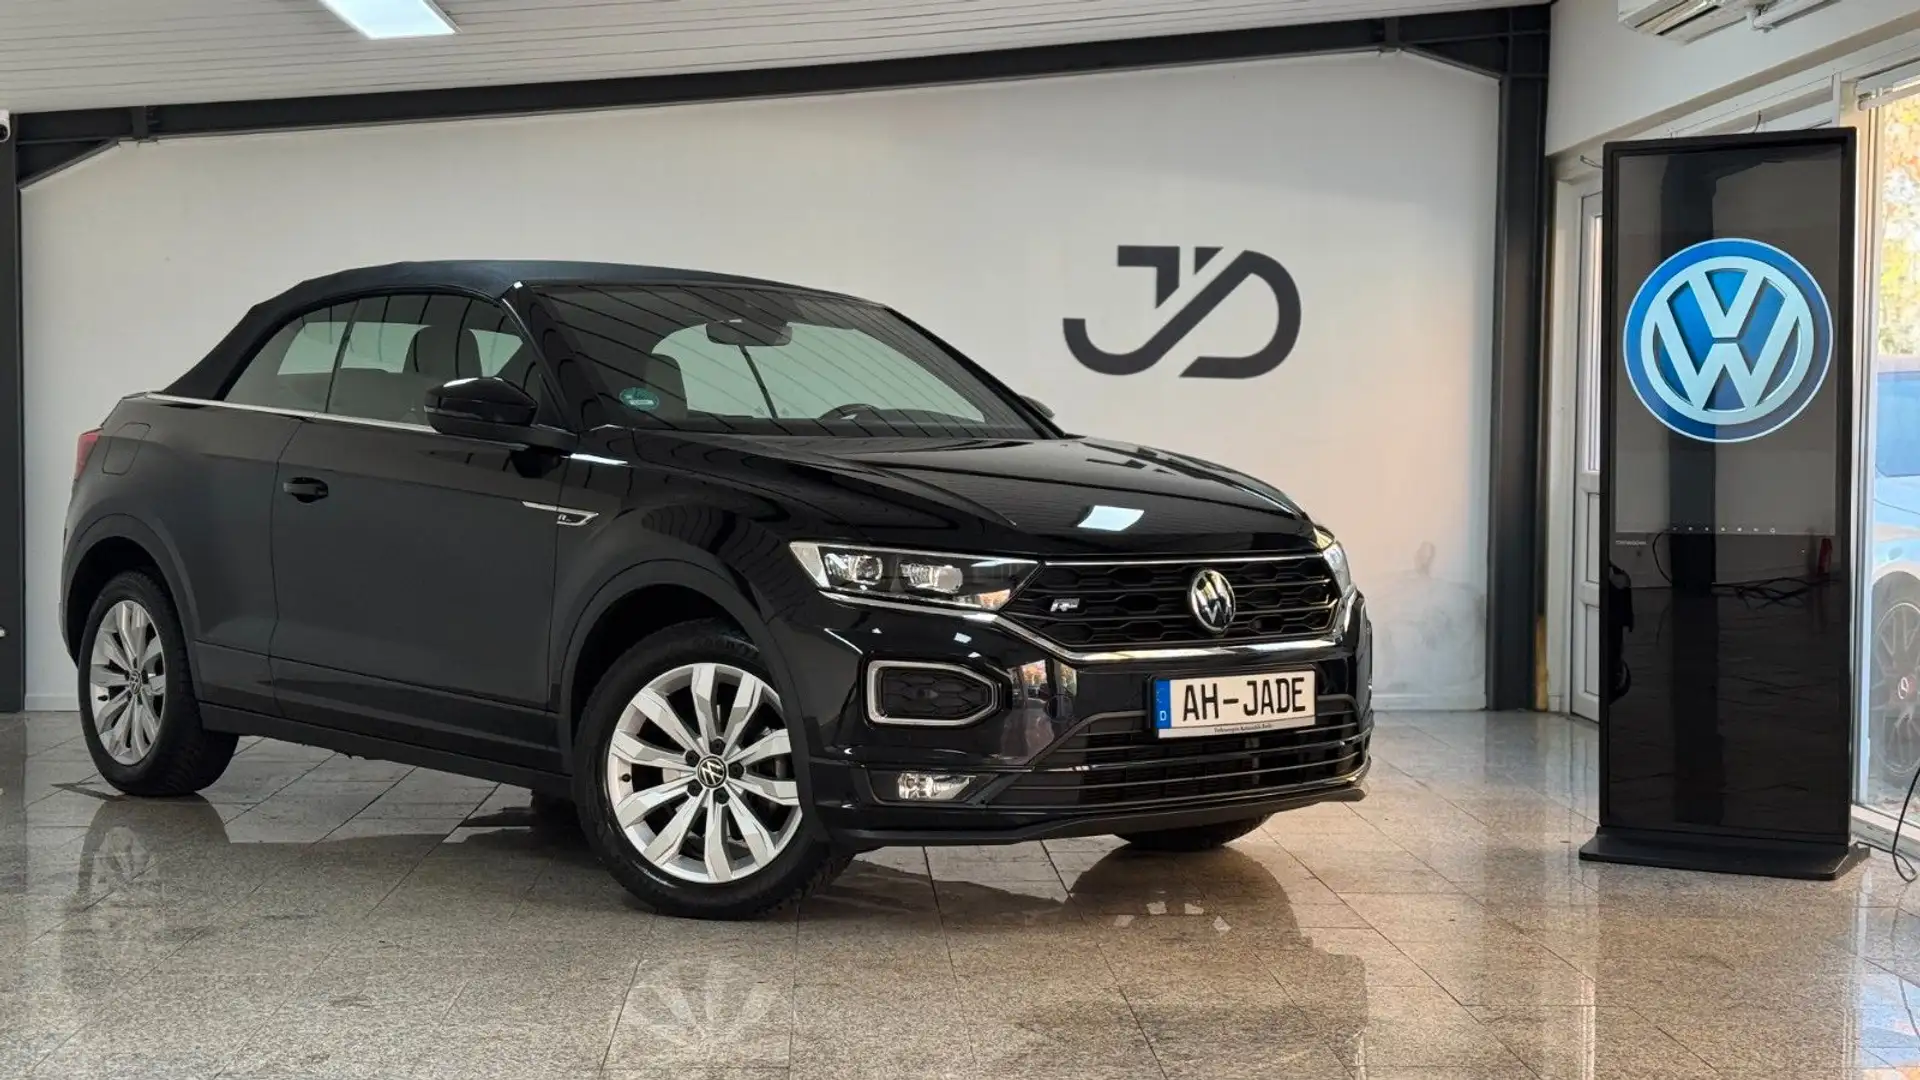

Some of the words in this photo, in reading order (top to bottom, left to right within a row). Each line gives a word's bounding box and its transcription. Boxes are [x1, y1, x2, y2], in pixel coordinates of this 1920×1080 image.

[1062, 245, 1301, 379] JD
[1159, 710, 1167, 722] D
[1182, 677, 1306, 722] AH-JADE
